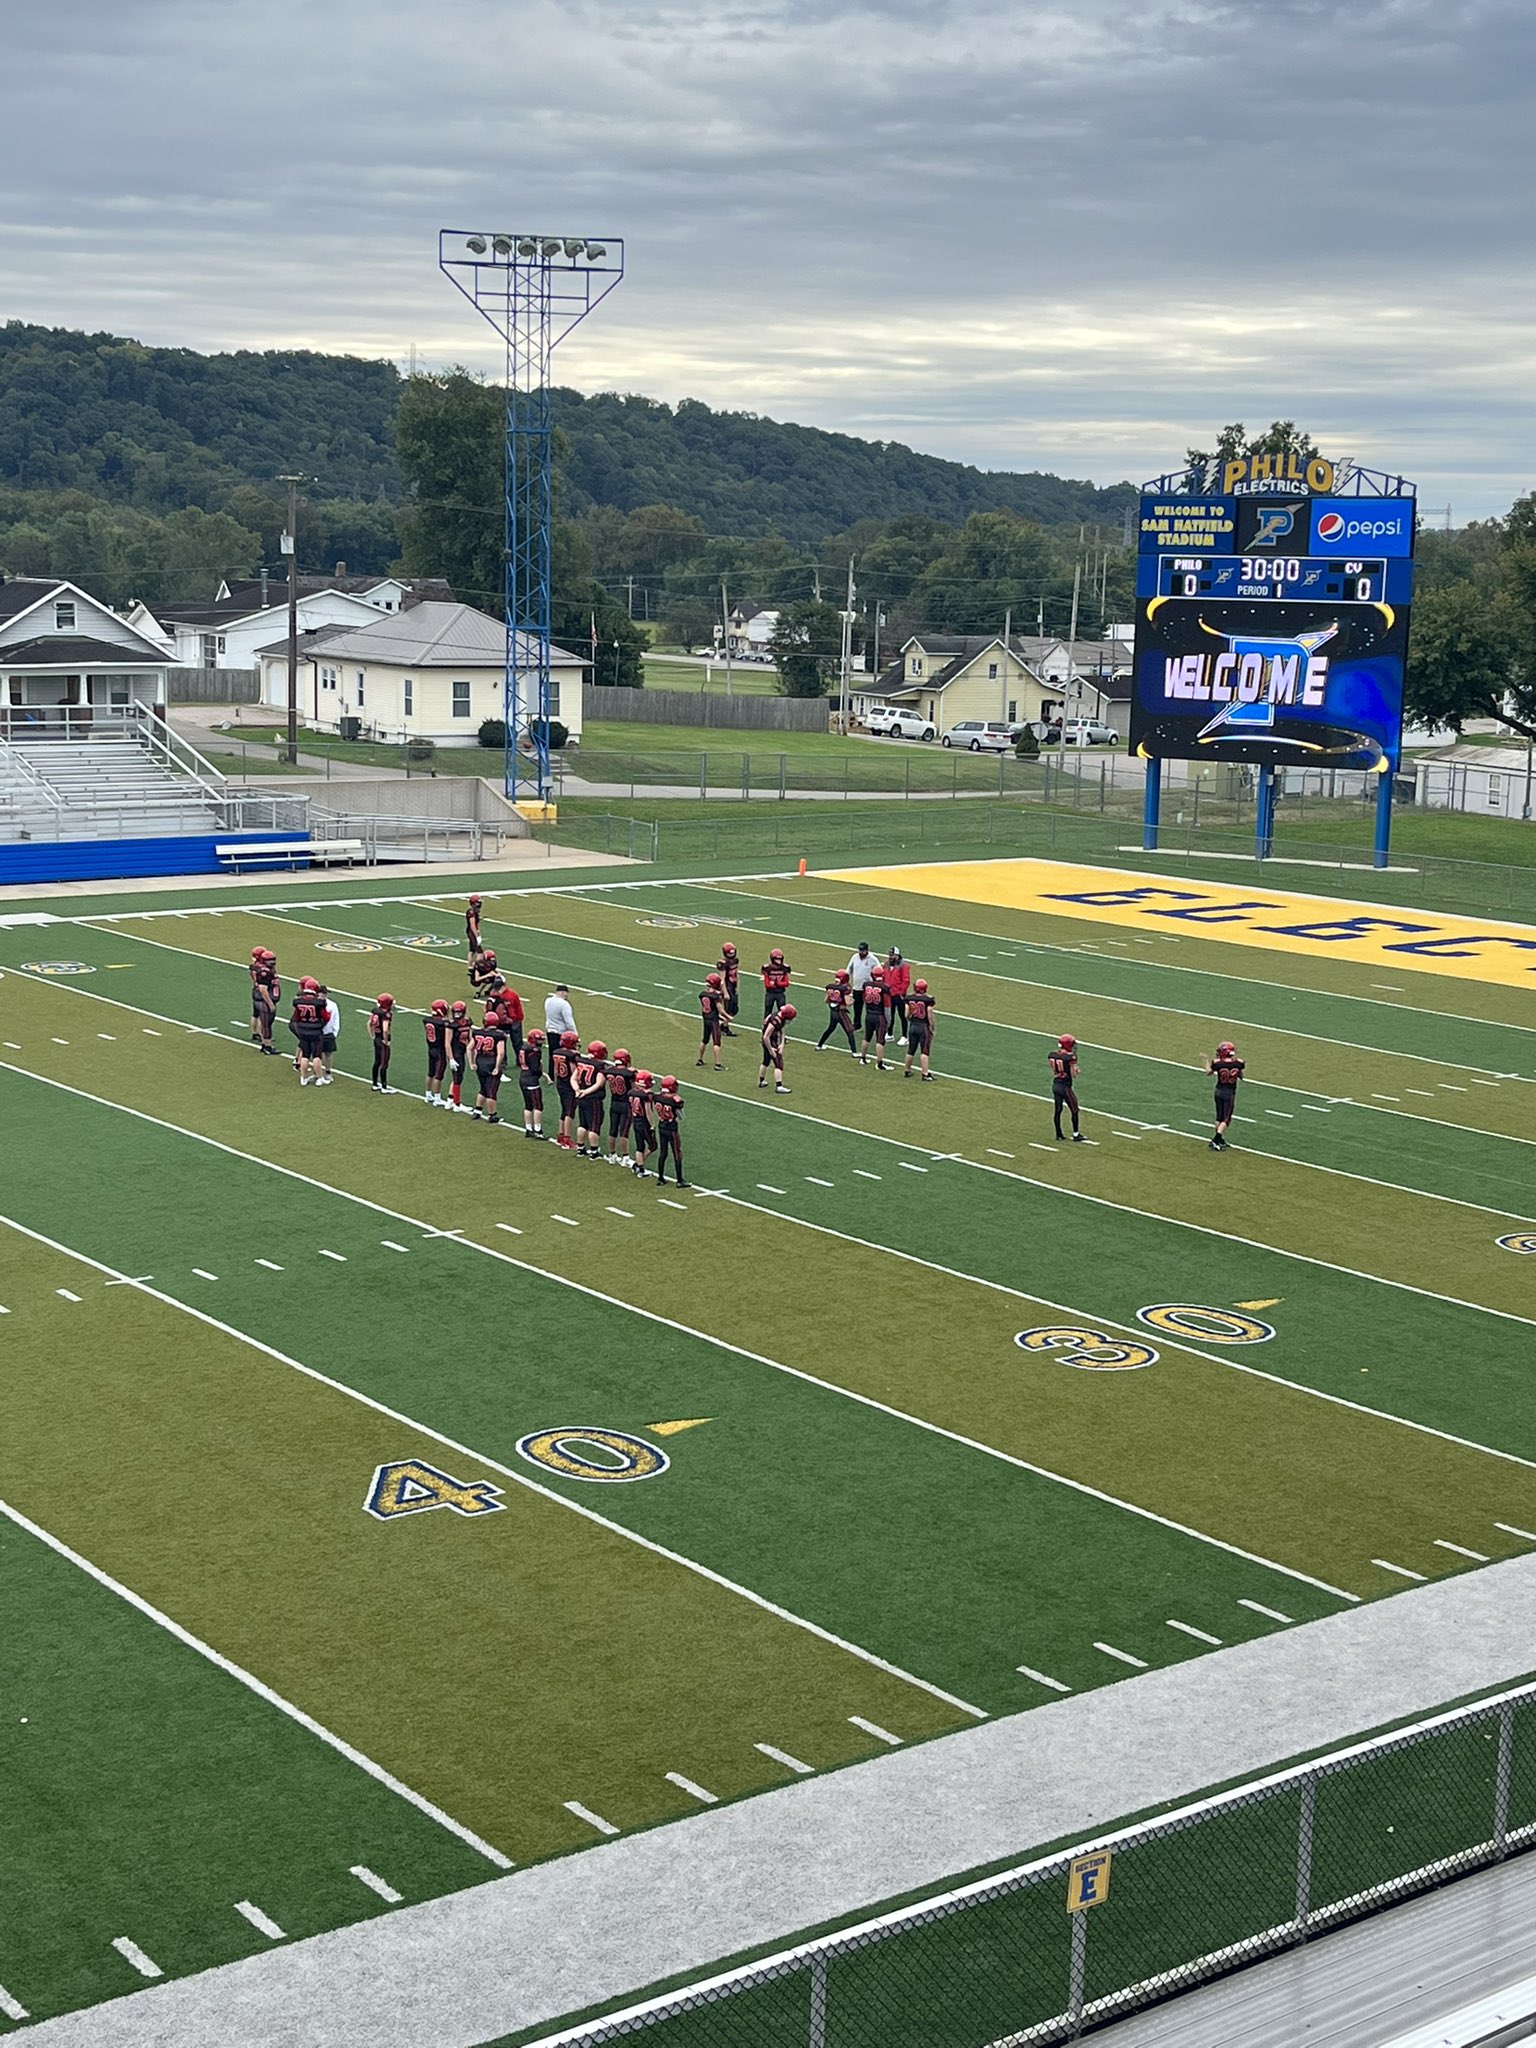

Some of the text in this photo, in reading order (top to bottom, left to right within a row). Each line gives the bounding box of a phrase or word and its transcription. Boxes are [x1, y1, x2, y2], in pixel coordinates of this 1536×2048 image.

[1223, 453, 1333, 494] PHILO
[1233, 479, 1309, 496] ELECTRICS
[1154, 506, 1225, 517] WELCOME TO
[1141, 519, 1234, 532] SAM HATFIELD
[1346, 518, 1402, 539] pepsi
[1157, 533, 1215, 546] STADIUM
[1174, 559, 1203, 571] PHILO
[1240, 558, 1300, 582] 30:00
[1344, 562, 1363, 574] CV
[1184, 574, 1197, 596] 0
[1237, 585, 1269, 596] PERIOD
[1357, 578, 1371, 600] 0
[1164, 652, 1329, 707] WELCOME
[1037, 887, 1536, 972] ELEC
[1079, 1867, 1099, 1903] E
